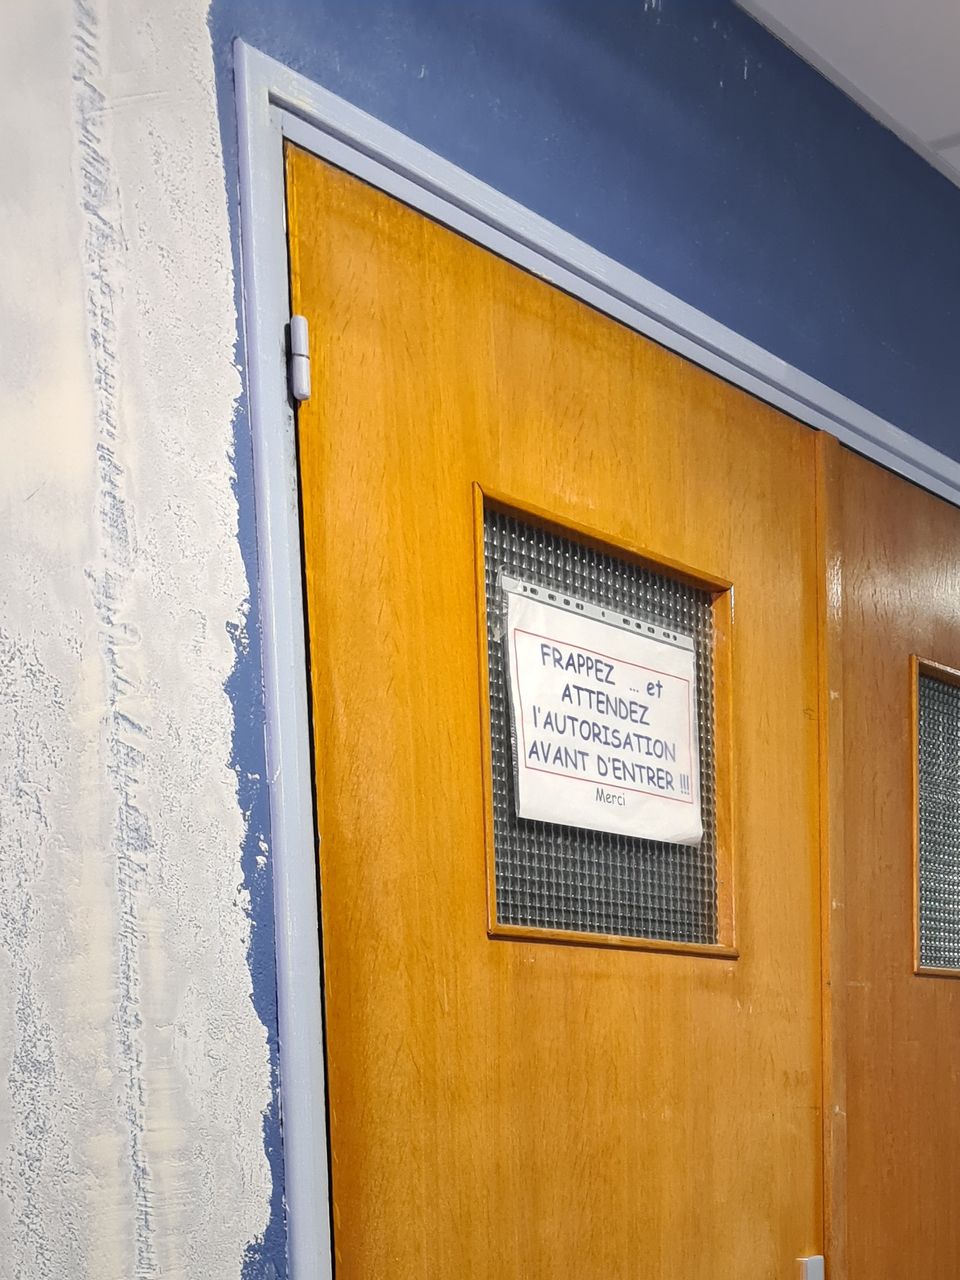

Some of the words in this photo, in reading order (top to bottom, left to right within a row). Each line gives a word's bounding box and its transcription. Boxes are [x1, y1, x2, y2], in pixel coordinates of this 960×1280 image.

[540, 643, 616, 686] FRAPPEZ
[646, 680, 664, 699] et
[561, 683, 650, 726] ATTENDEZ
[532, 705, 676, 763] l'AUTORISATION
[528, 740, 589, 772] AVANT
[597, 755, 675, 792] D'ENTRER
[595, 787, 626, 807] Merci
